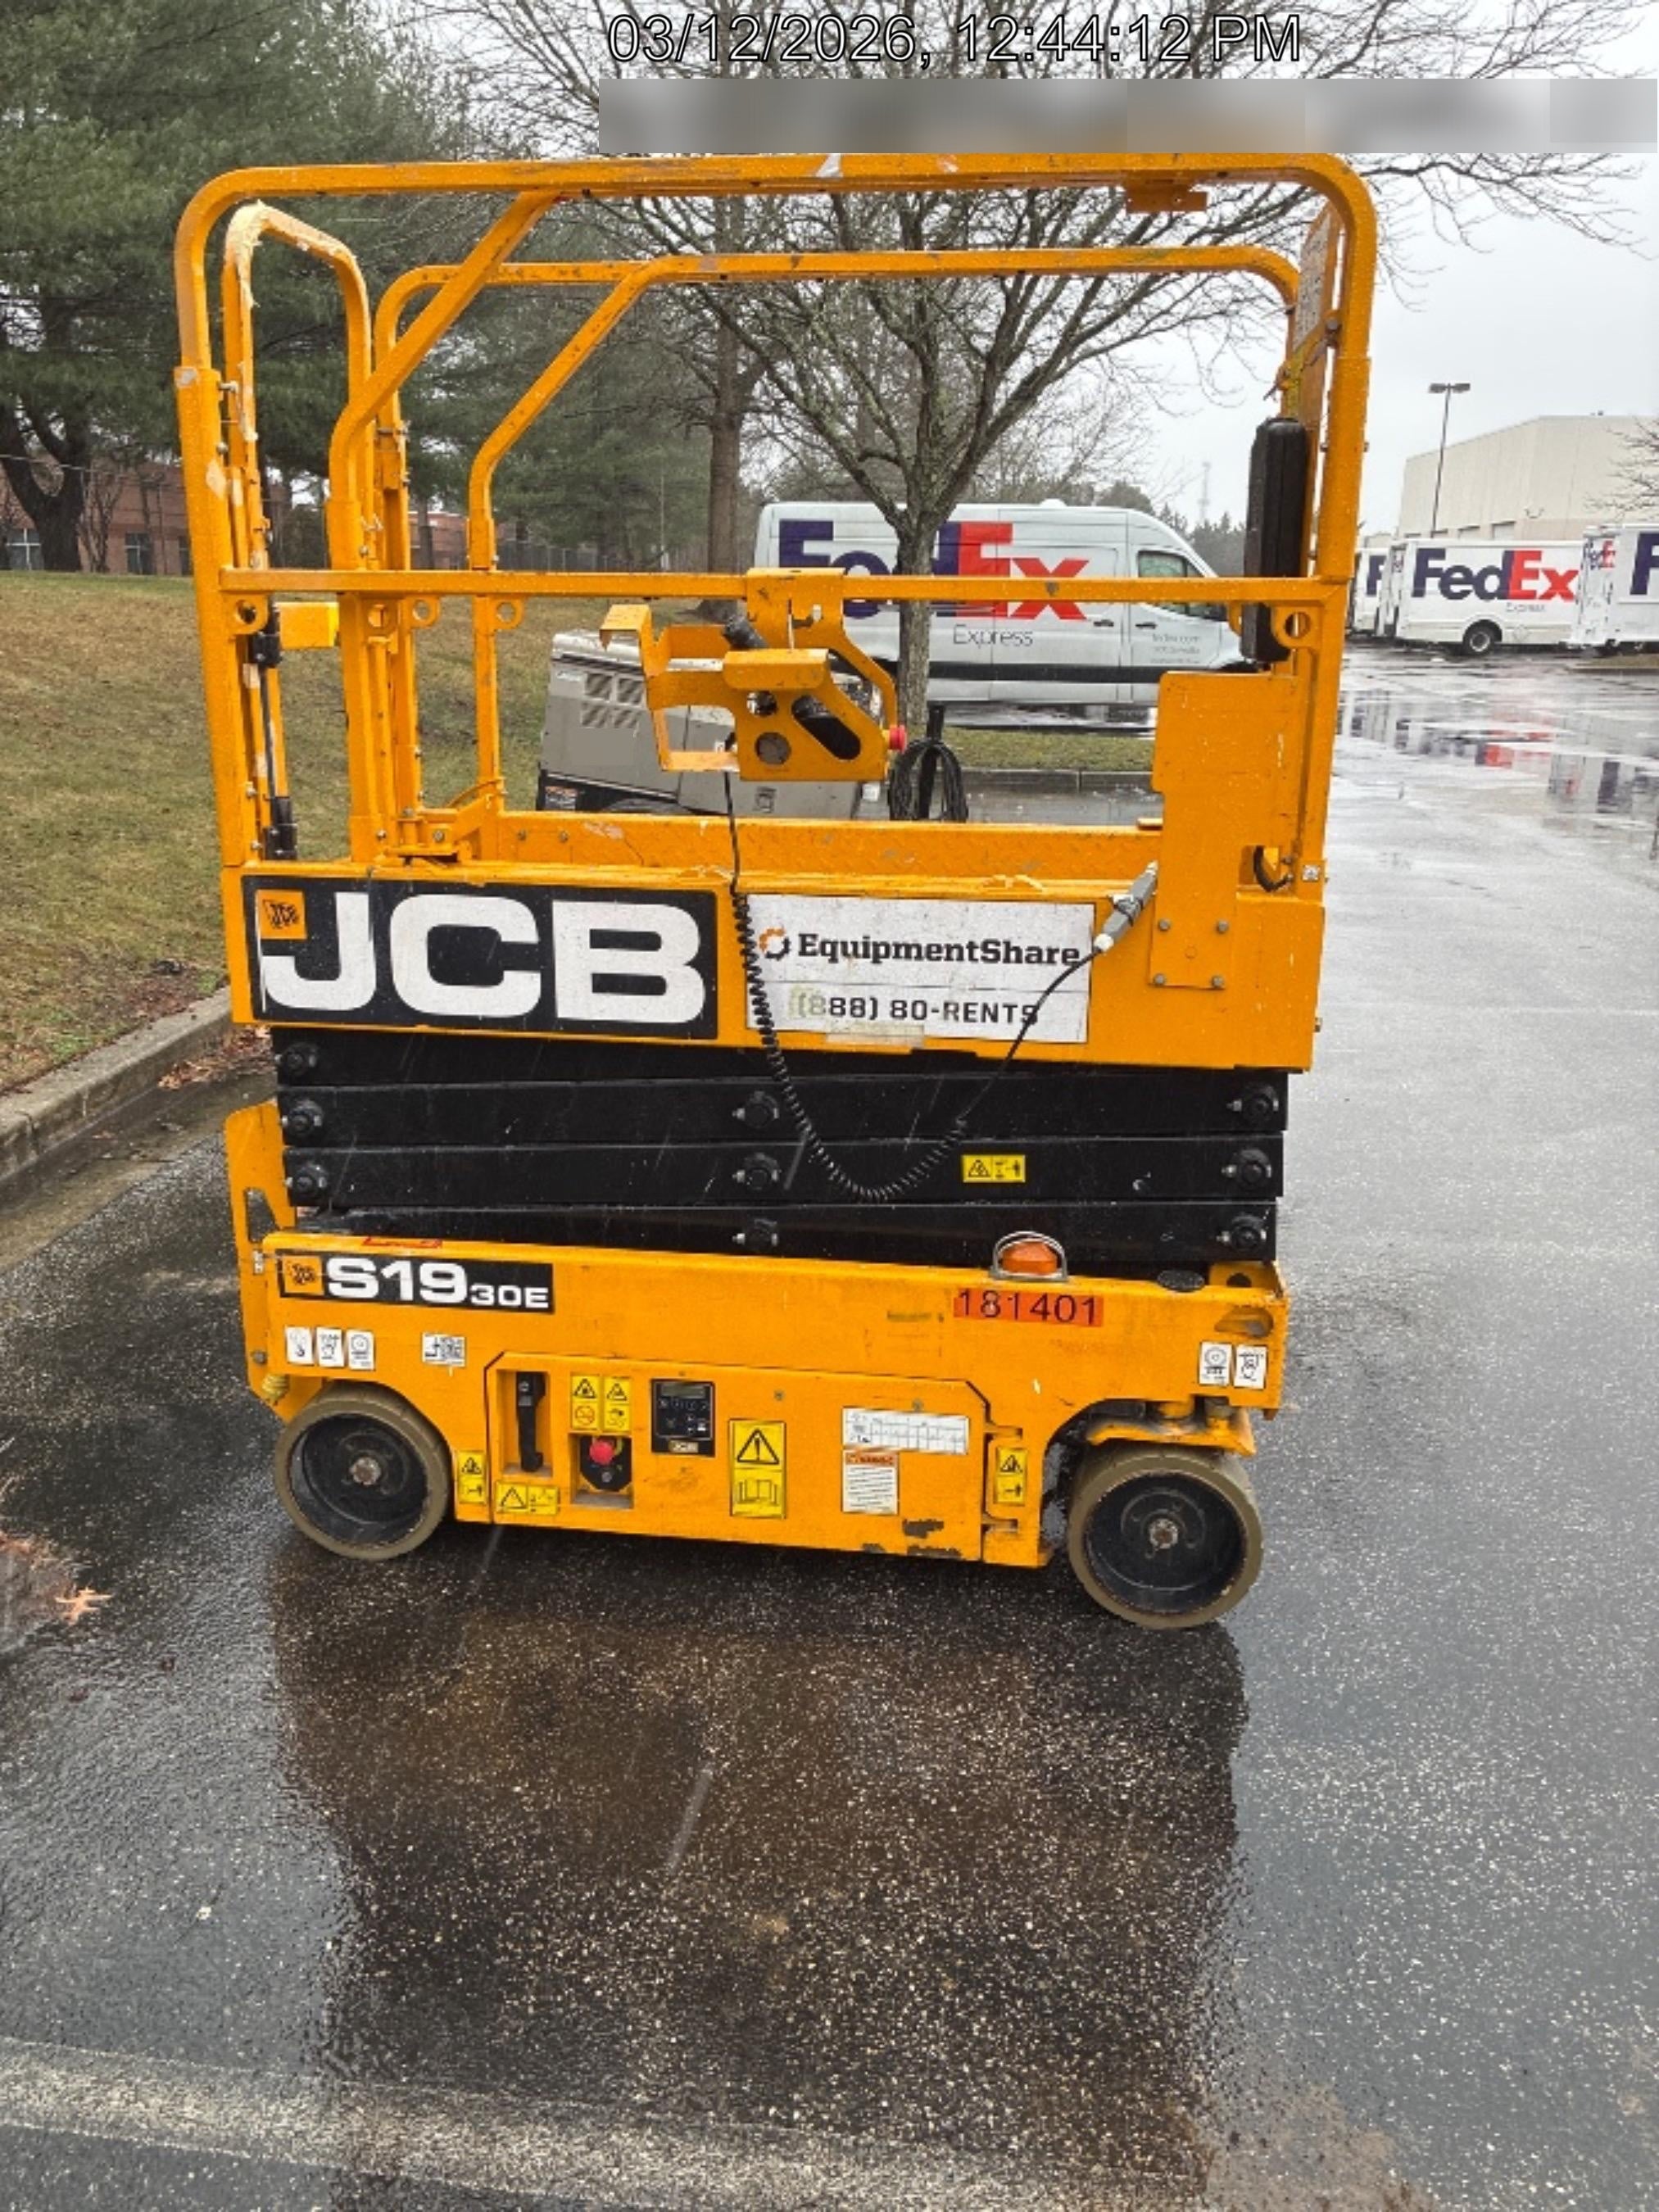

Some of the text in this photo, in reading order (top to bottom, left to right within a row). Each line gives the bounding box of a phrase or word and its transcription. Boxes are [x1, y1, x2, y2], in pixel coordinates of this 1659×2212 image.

[1411, 548, 1580, 602] FedEx
[954, 624, 1034, 648] Express
[263, 891, 705, 1023] JCB
[798, 933, 1080, 967] EquipmentShare
[890, 999, 1039, 1025] 80-RENTS
[959, 1289, 1097, 1326] 181401
